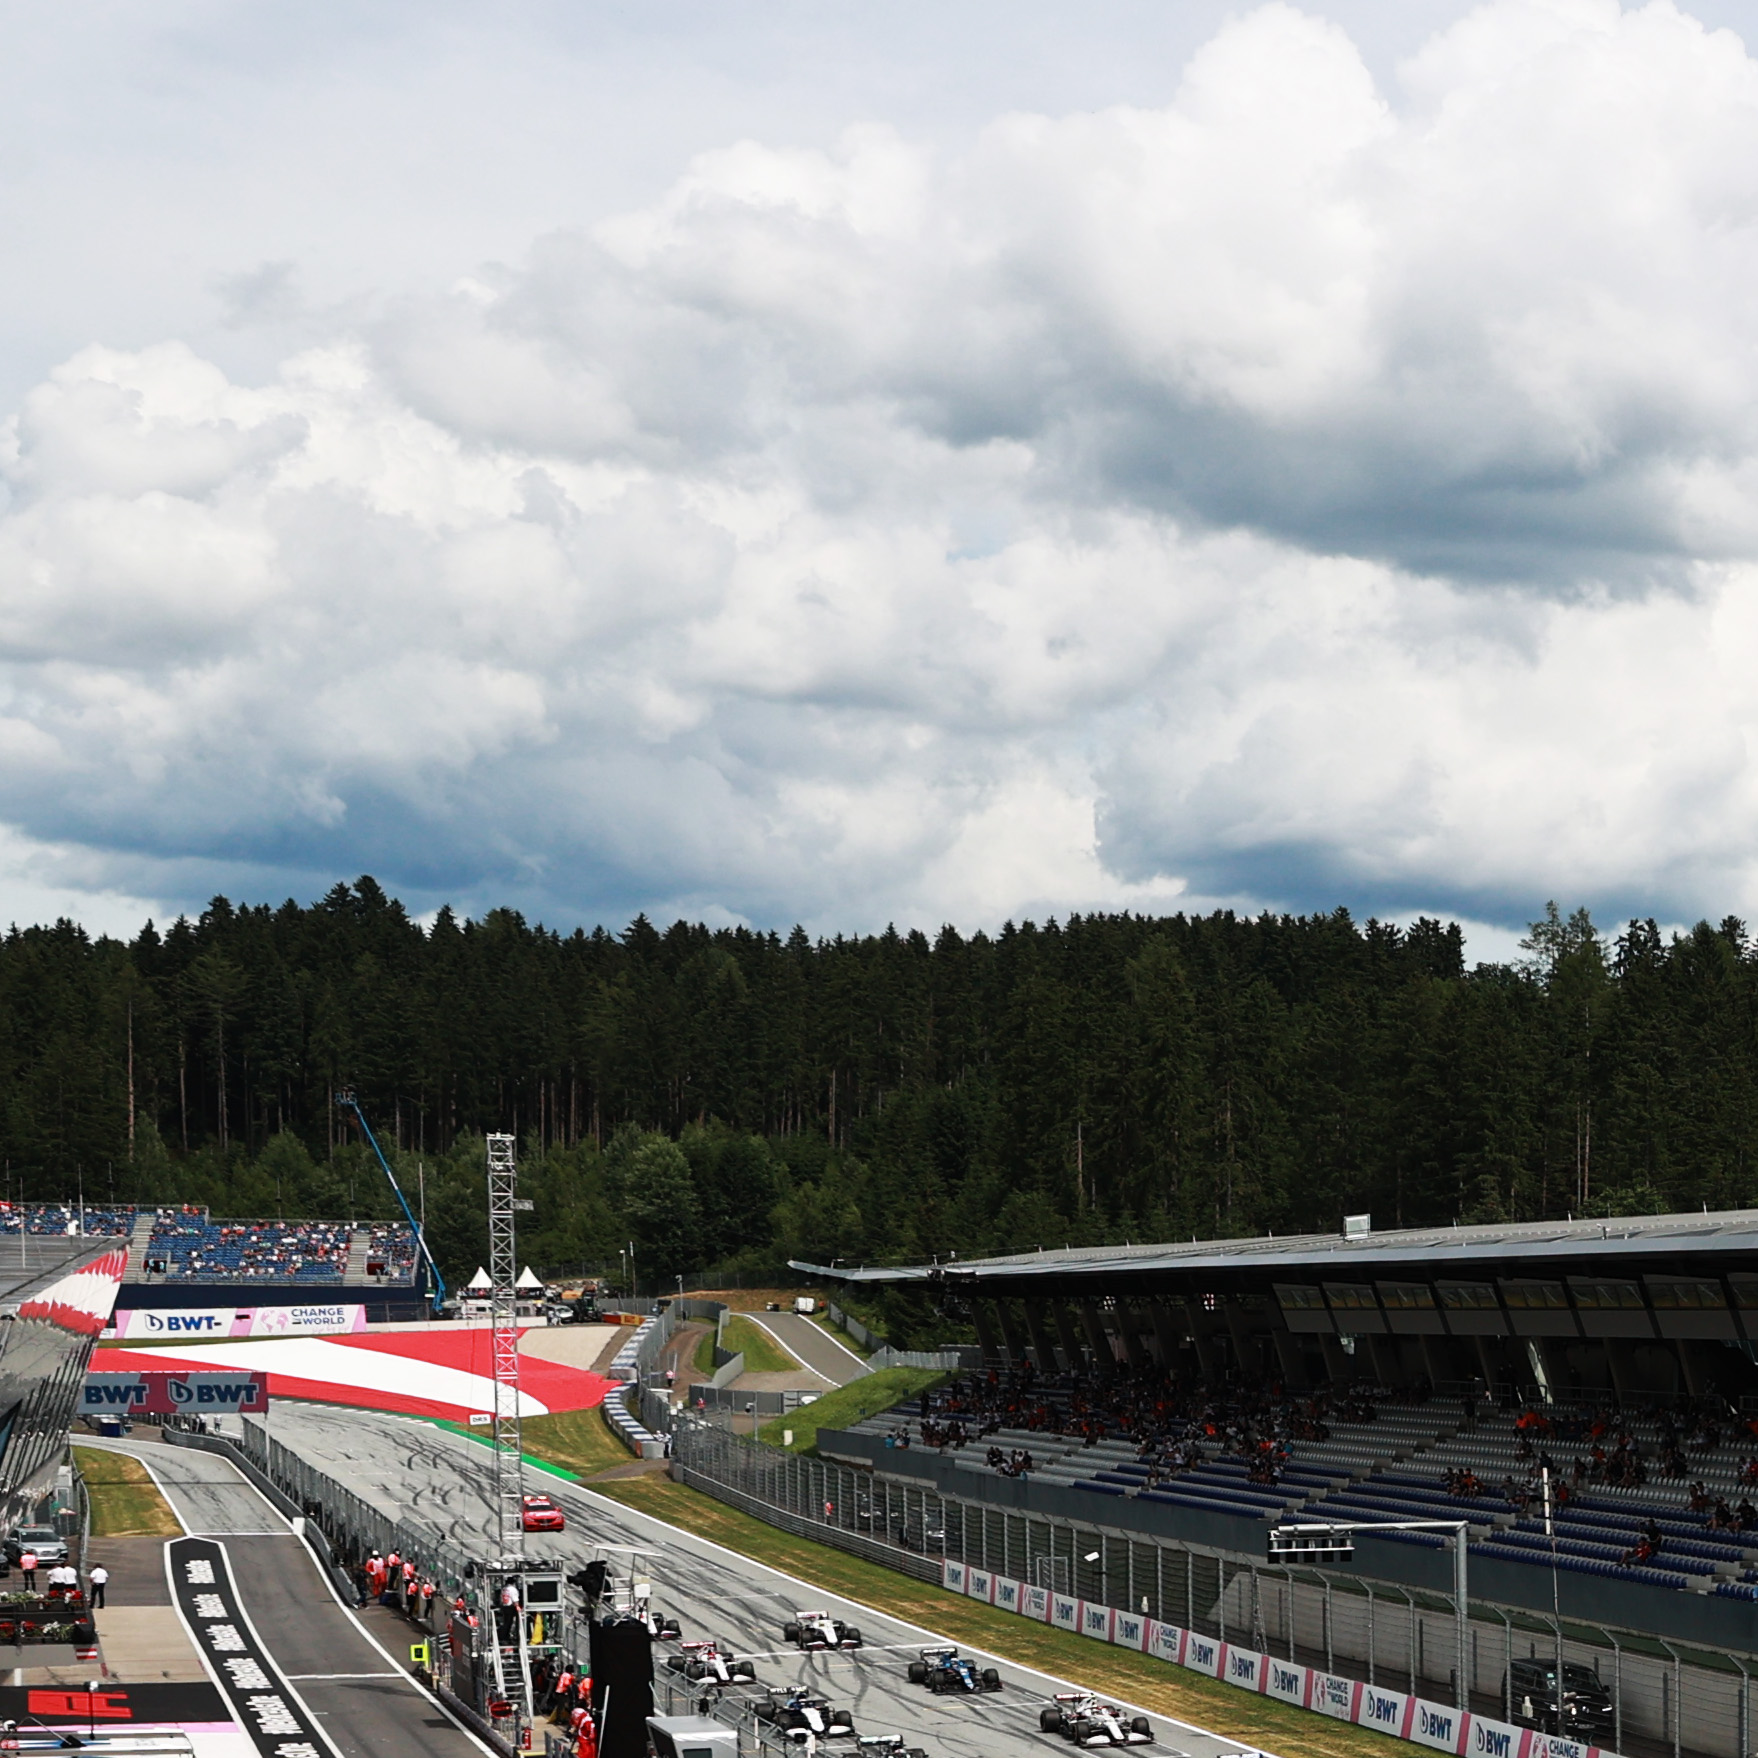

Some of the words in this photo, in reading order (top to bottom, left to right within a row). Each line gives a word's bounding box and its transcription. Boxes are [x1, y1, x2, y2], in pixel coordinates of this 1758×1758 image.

[291, 1307, 344, 1317] CHANGE
[303, 1317, 345, 1325] WORLD
[168, 1316, 215, 1330] BWT
[85, 1384, 148, 1404] BWT
[196, 1383, 258, 1404] BWT
[1060, 1602, 1073, 1622] BWT
[1092, 1611, 1105, 1631] BWT
[1124, 1621, 1138, 1641] BWT
[1197, 1643, 1213, 1667] BWT
[1237, 1660, 1254, 1681] BWT
[1280, 1672, 1298, 1696] BWT
[1327, 1677, 1348, 1694] CHANGE
[1330, 1691, 1348, 1707] WORLD
[1376, 1701, 1397, 1724] BWT
[1429, 1714, 1452, 1741] BWT
[1486, 1732, 1510, 1758] BWT
[1549, 1739, 1579, 1758] CHANGE
